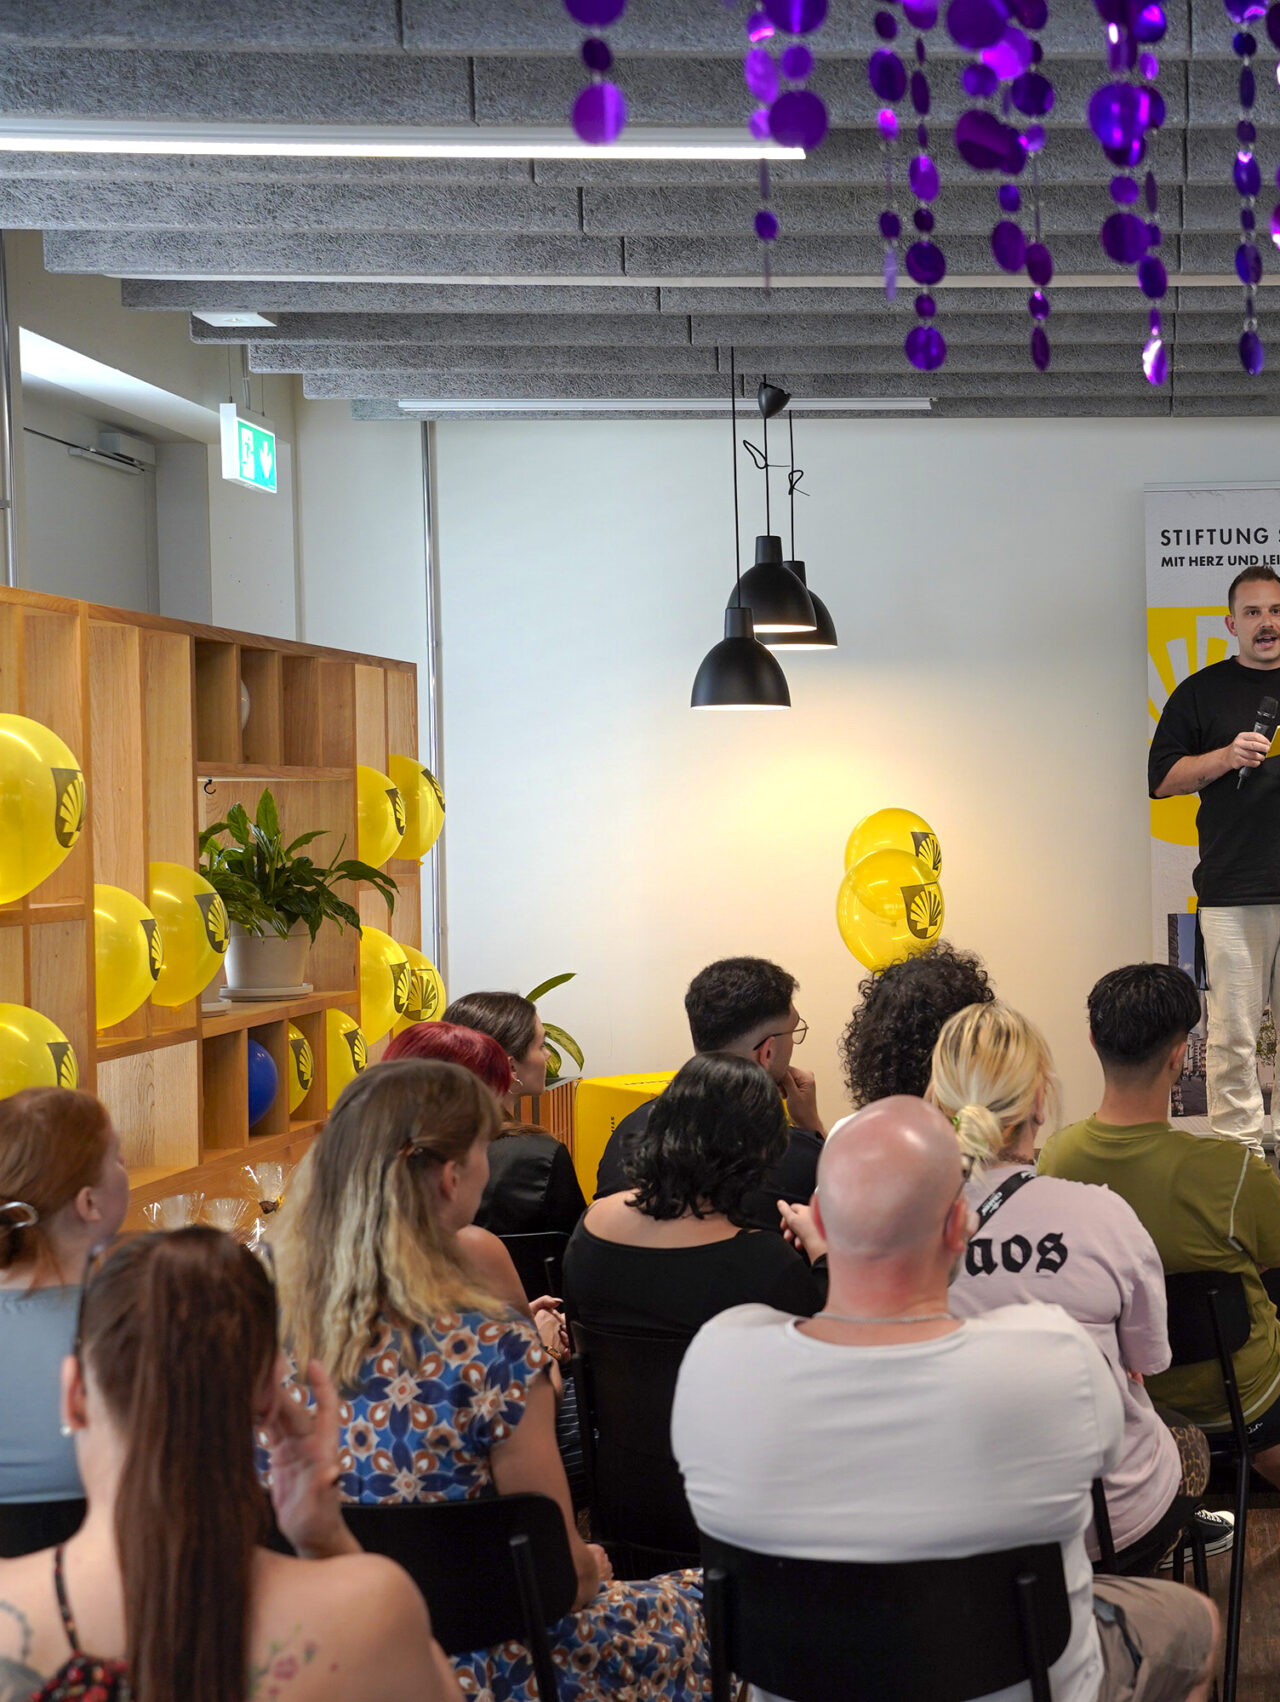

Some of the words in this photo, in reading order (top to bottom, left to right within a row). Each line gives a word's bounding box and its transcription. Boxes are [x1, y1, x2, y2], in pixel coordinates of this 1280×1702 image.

[1160, 527, 1269, 547] STIFTUNG
[1160, 556, 1186, 568] MIT
[1188, 555, 1224, 567] HERZ
[1227, 554, 1259, 566] UND
[965, 1232, 1068, 1277] aos
